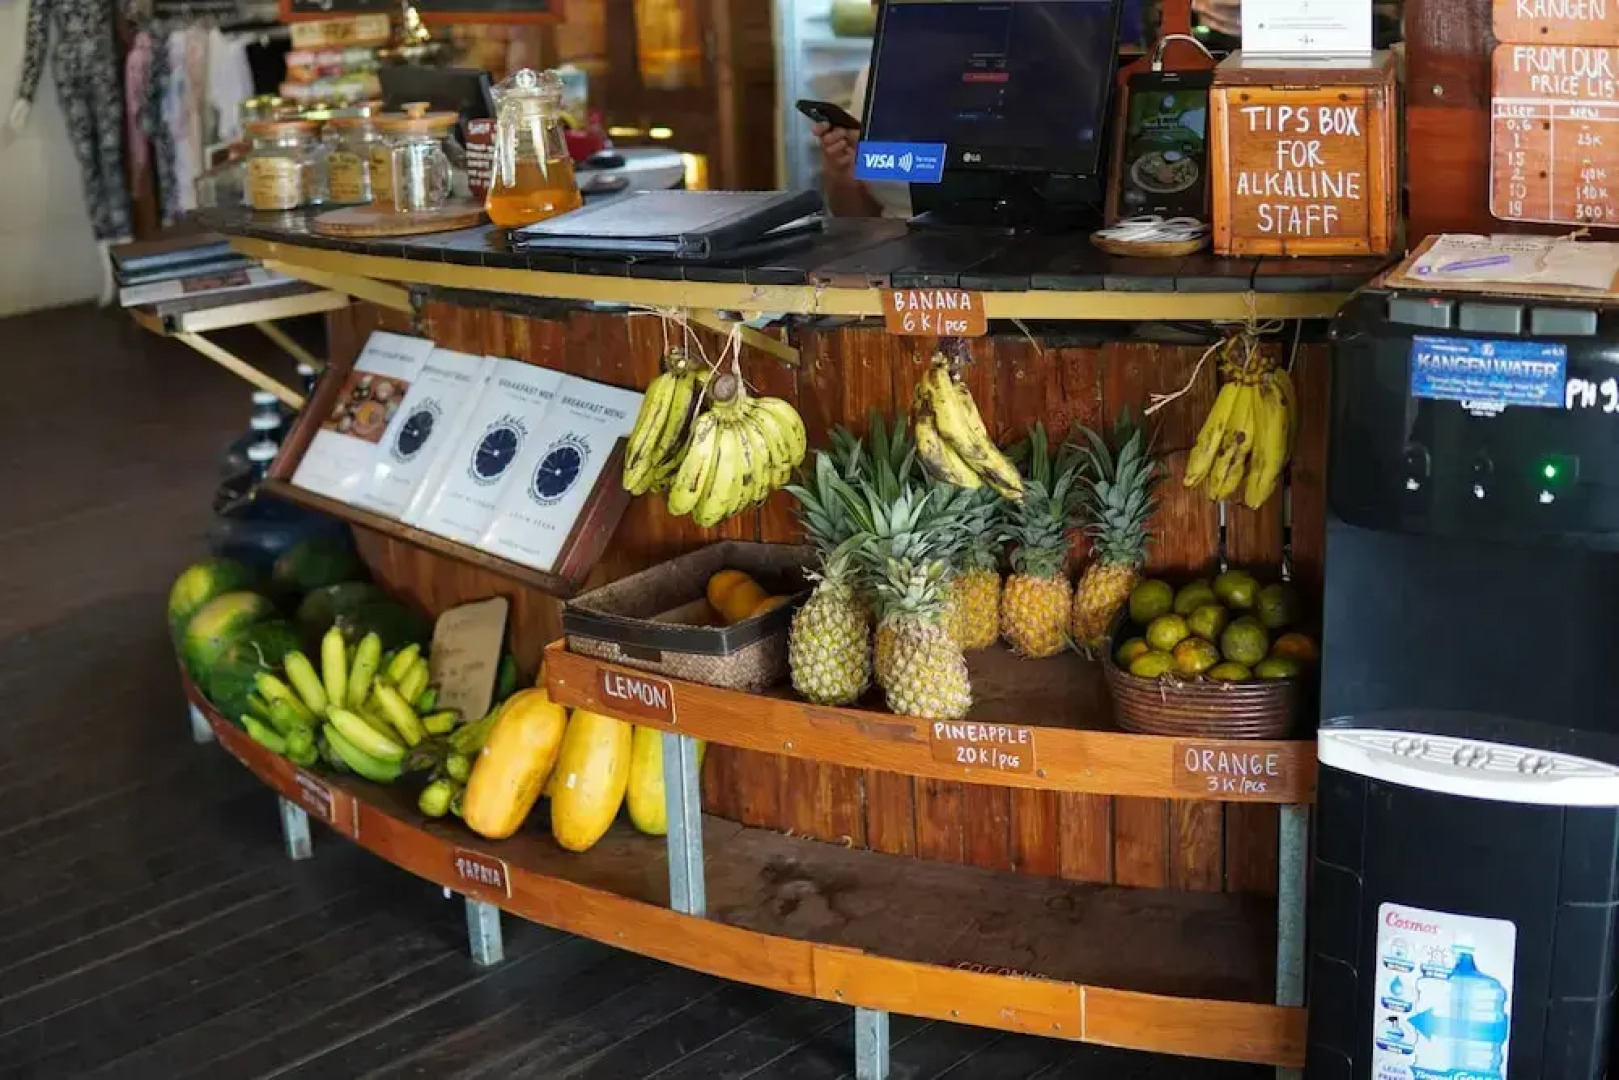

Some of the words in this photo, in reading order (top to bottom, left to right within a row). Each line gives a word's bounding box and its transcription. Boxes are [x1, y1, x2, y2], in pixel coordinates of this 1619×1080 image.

[1516, 0, 1606, 20] KANGEN
[1513, 46, 1567, 74] FROM
[1571, 47, 1615, 79] OUR
[1531, 74, 1580, 97] PRICE
[1240, 104, 1311, 133] TIPS
[1318, 106, 1361, 137] BOX
[864, 153, 895, 169] VISA
[1276, 140, 1326, 171] FOR
[1236, 170, 1361, 200] ALKALINE
[1257, 203, 1339, 236] STAFF
[893, 289, 972, 312] BANANA
[1417, 352, 1493, 371] KANGEN
[604, 671, 668, 710] LEMON
[933, 721, 1029, 744] PINEAPPLE
[1184, 747, 1280, 776] ORANGE
[1385, 911, 1440, 934] Cosmos
